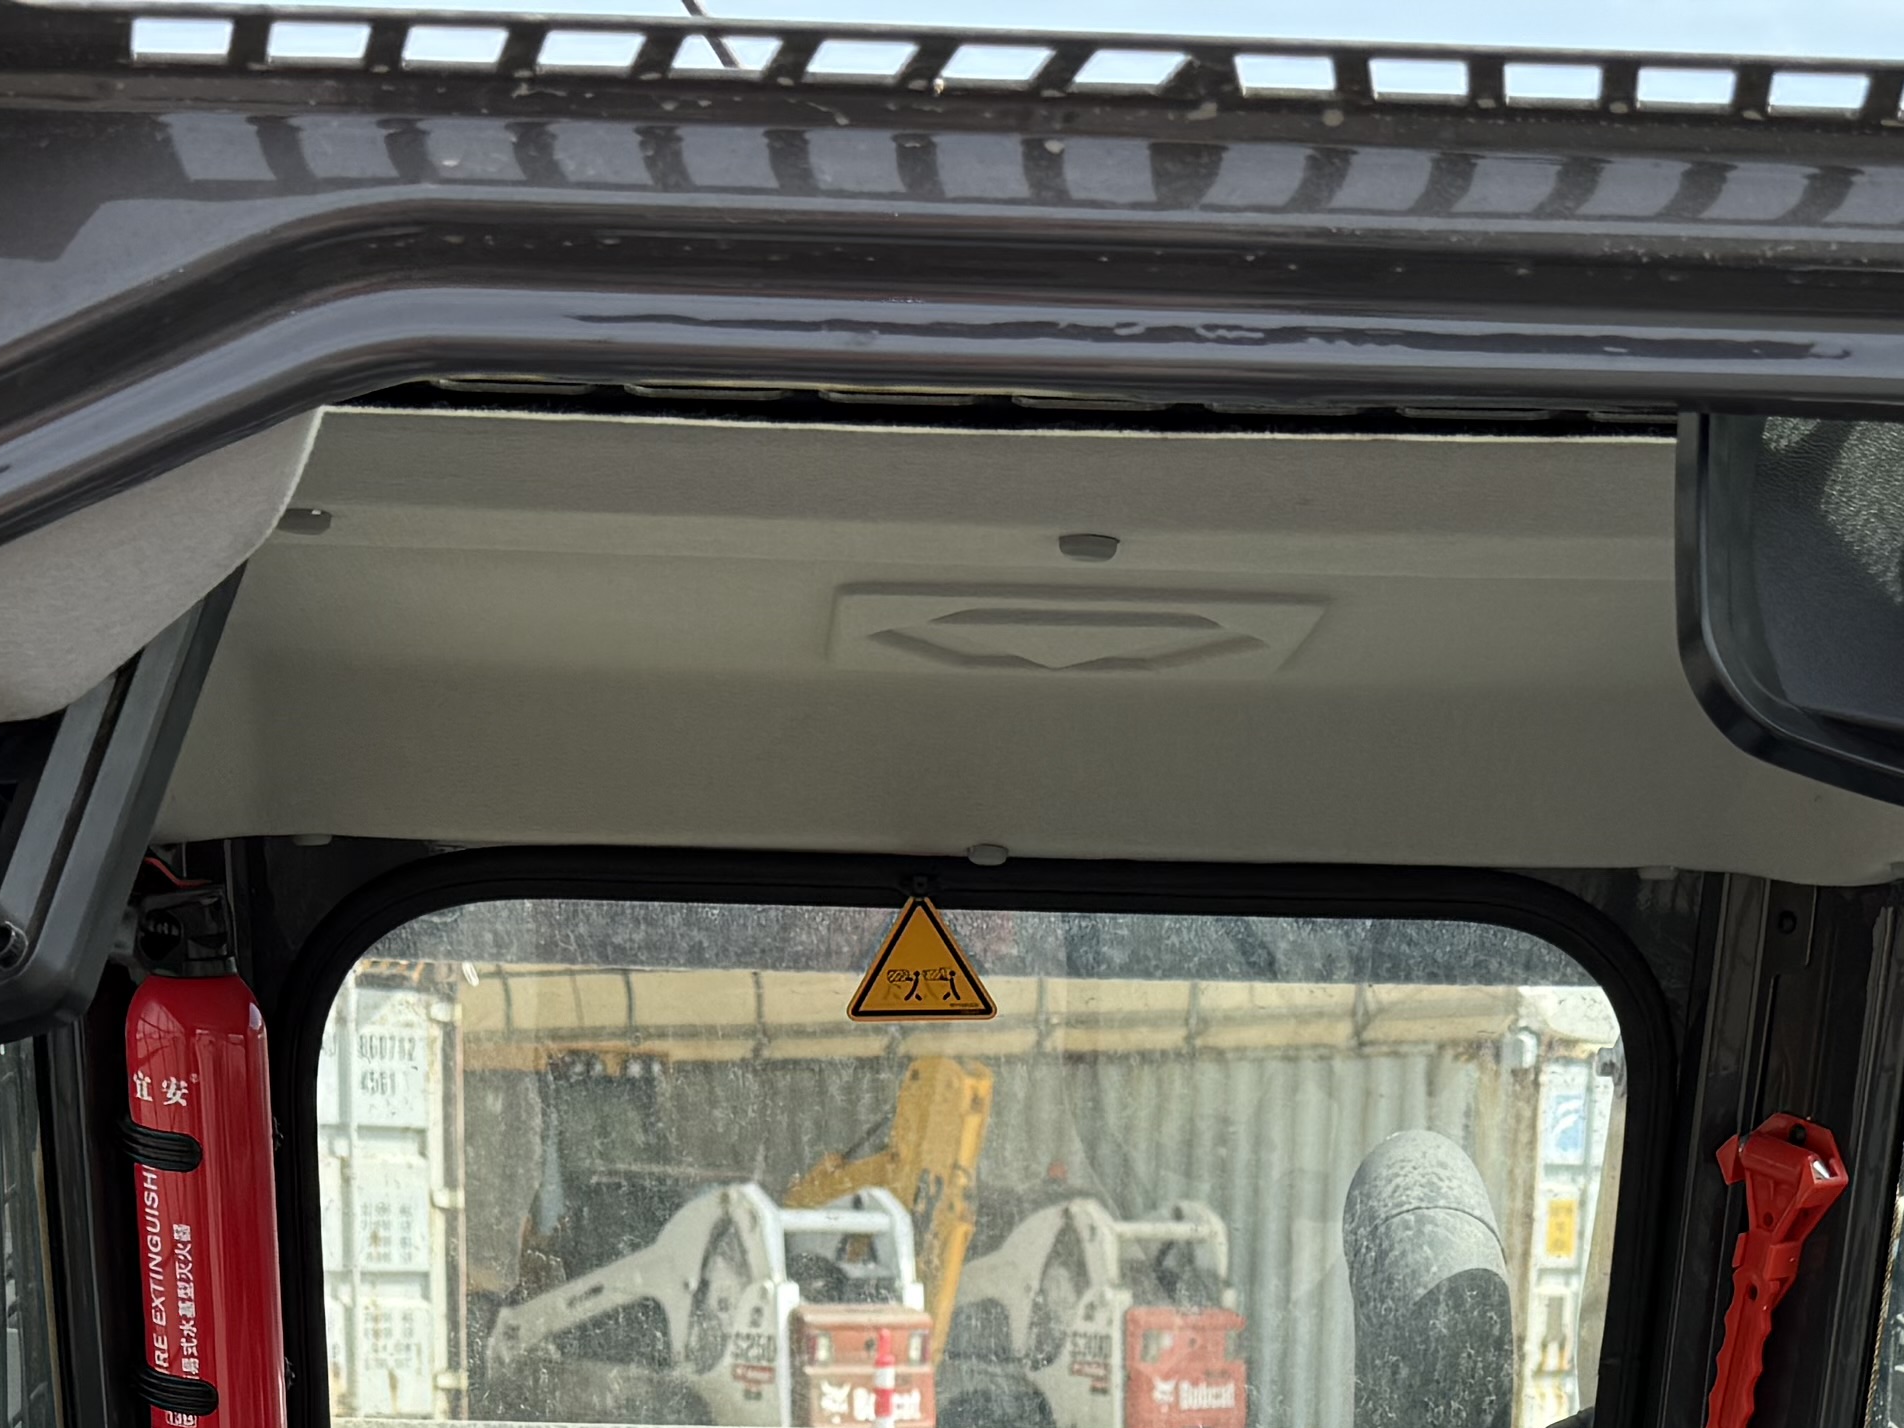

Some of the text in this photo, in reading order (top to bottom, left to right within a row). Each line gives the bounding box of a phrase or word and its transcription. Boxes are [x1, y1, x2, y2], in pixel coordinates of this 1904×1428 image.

[142, 1163, 167, 1327] EXTINGUISH
[173, 1223, 201, 1380] 易式水基型灭火器
